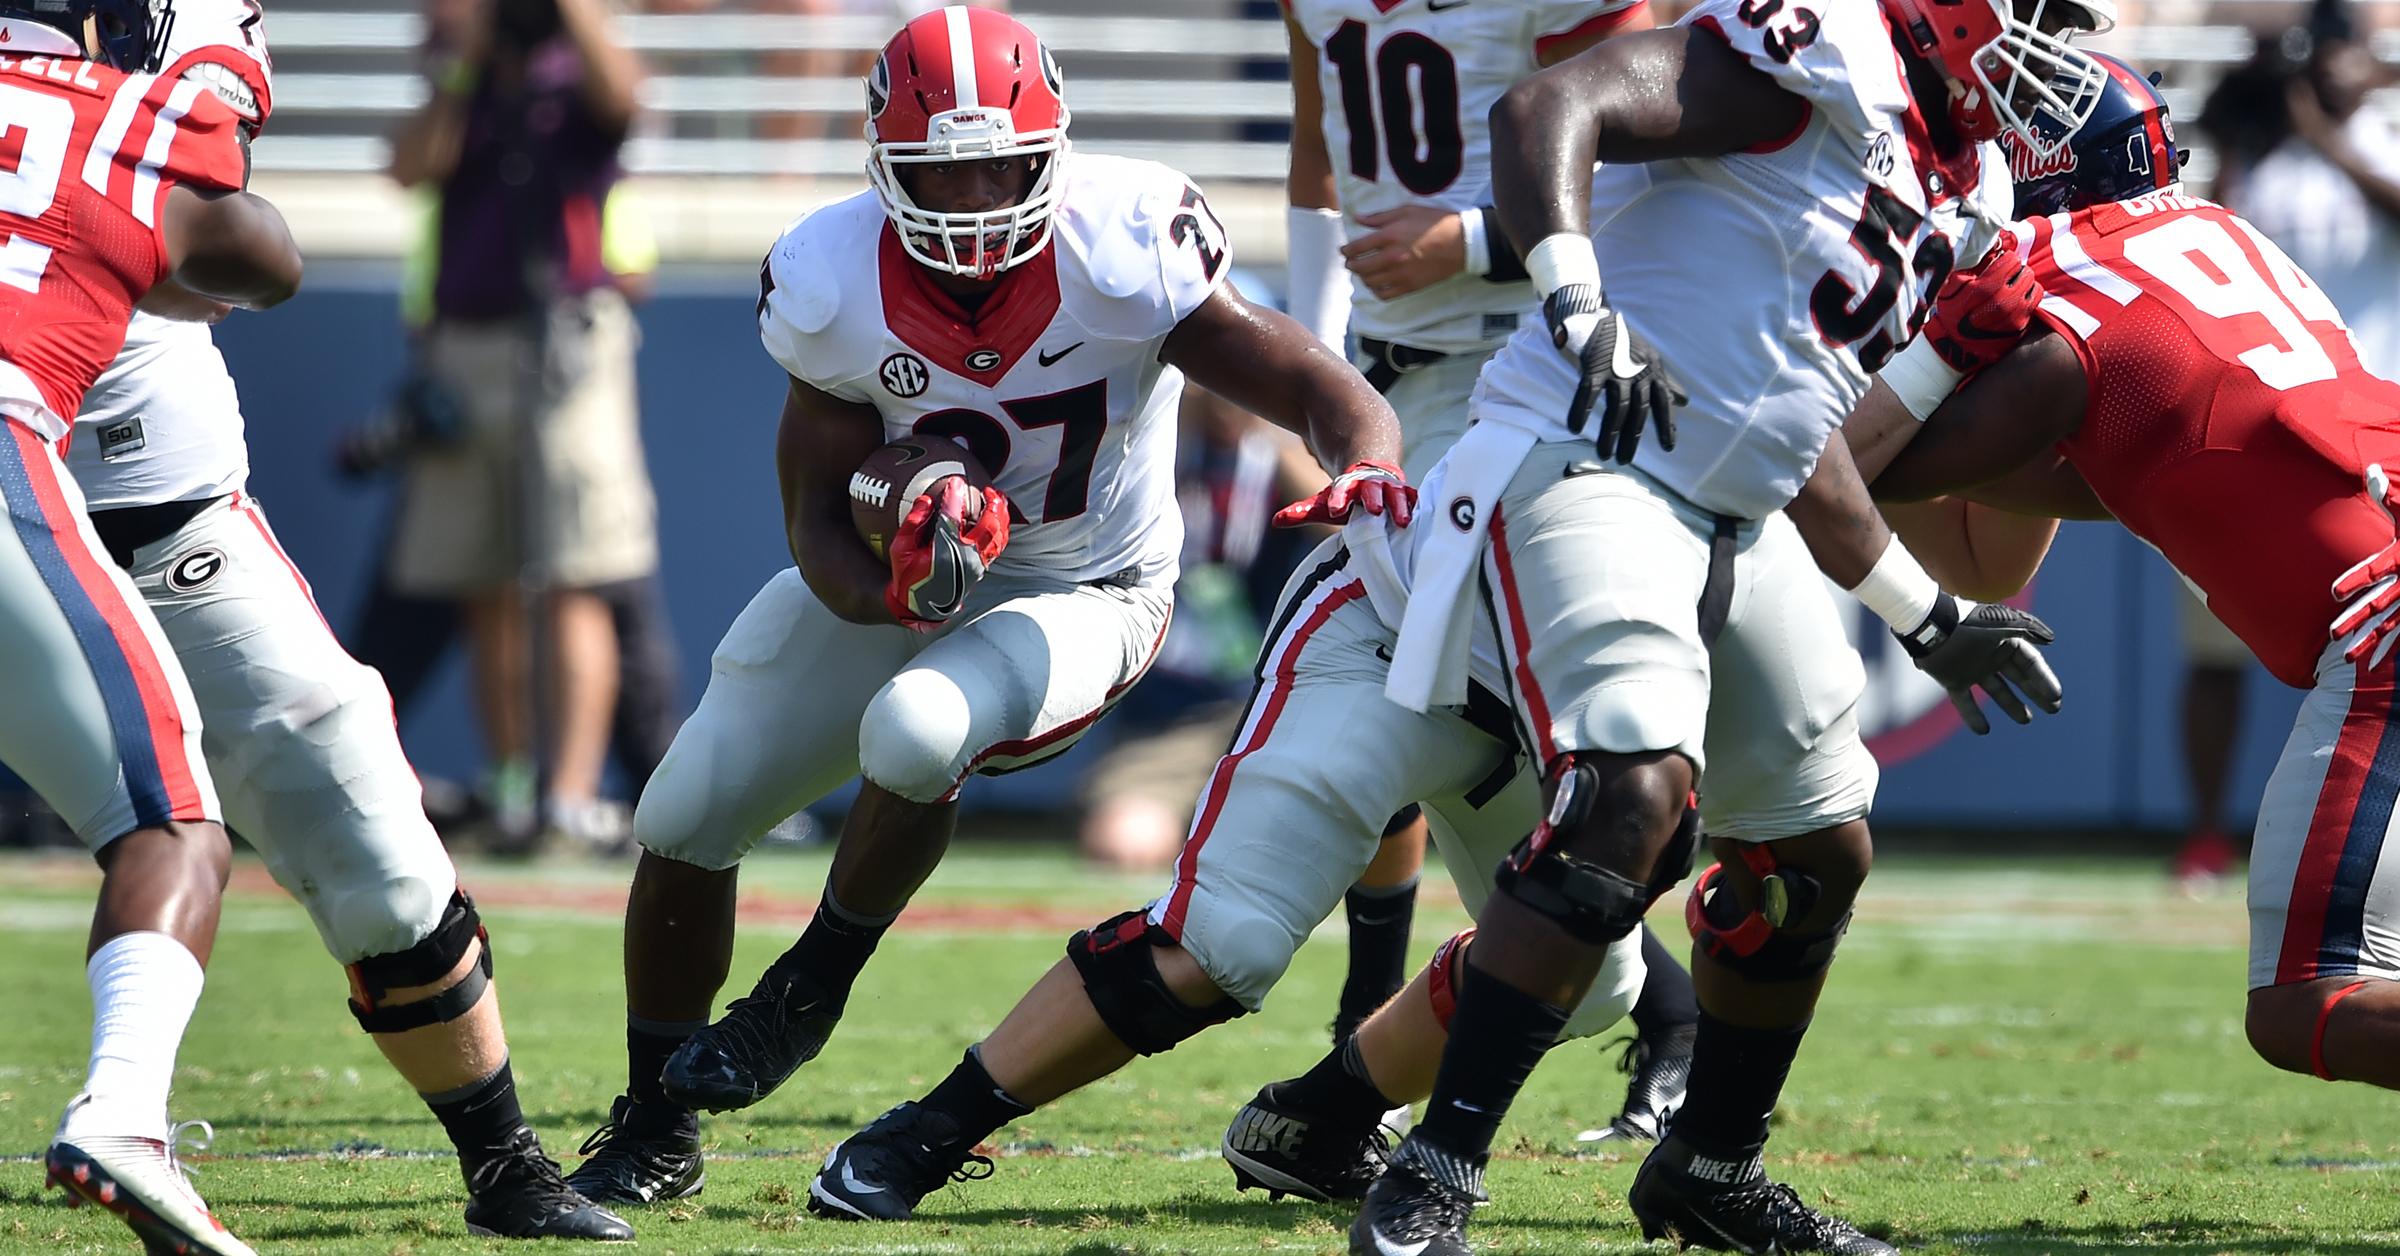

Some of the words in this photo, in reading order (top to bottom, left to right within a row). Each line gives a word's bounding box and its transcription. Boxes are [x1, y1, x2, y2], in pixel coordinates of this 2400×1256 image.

[952, 113, 987, 124] DAWGS
[1325, 18, 1464, 195] 10
[2001, 124, 2078, 184] Miss
[1809, 182, 1957, 375] 53
[2122, 214, 2370, 392] 94
[883, 355, 926, 397] SEC
[107, 426, 133, 444] 50
[911, 378, 1108, 525] 27
[1227, 1105, 1309, 1160] NIKE
[1687, 1154, 1738, 1184] NIKE
